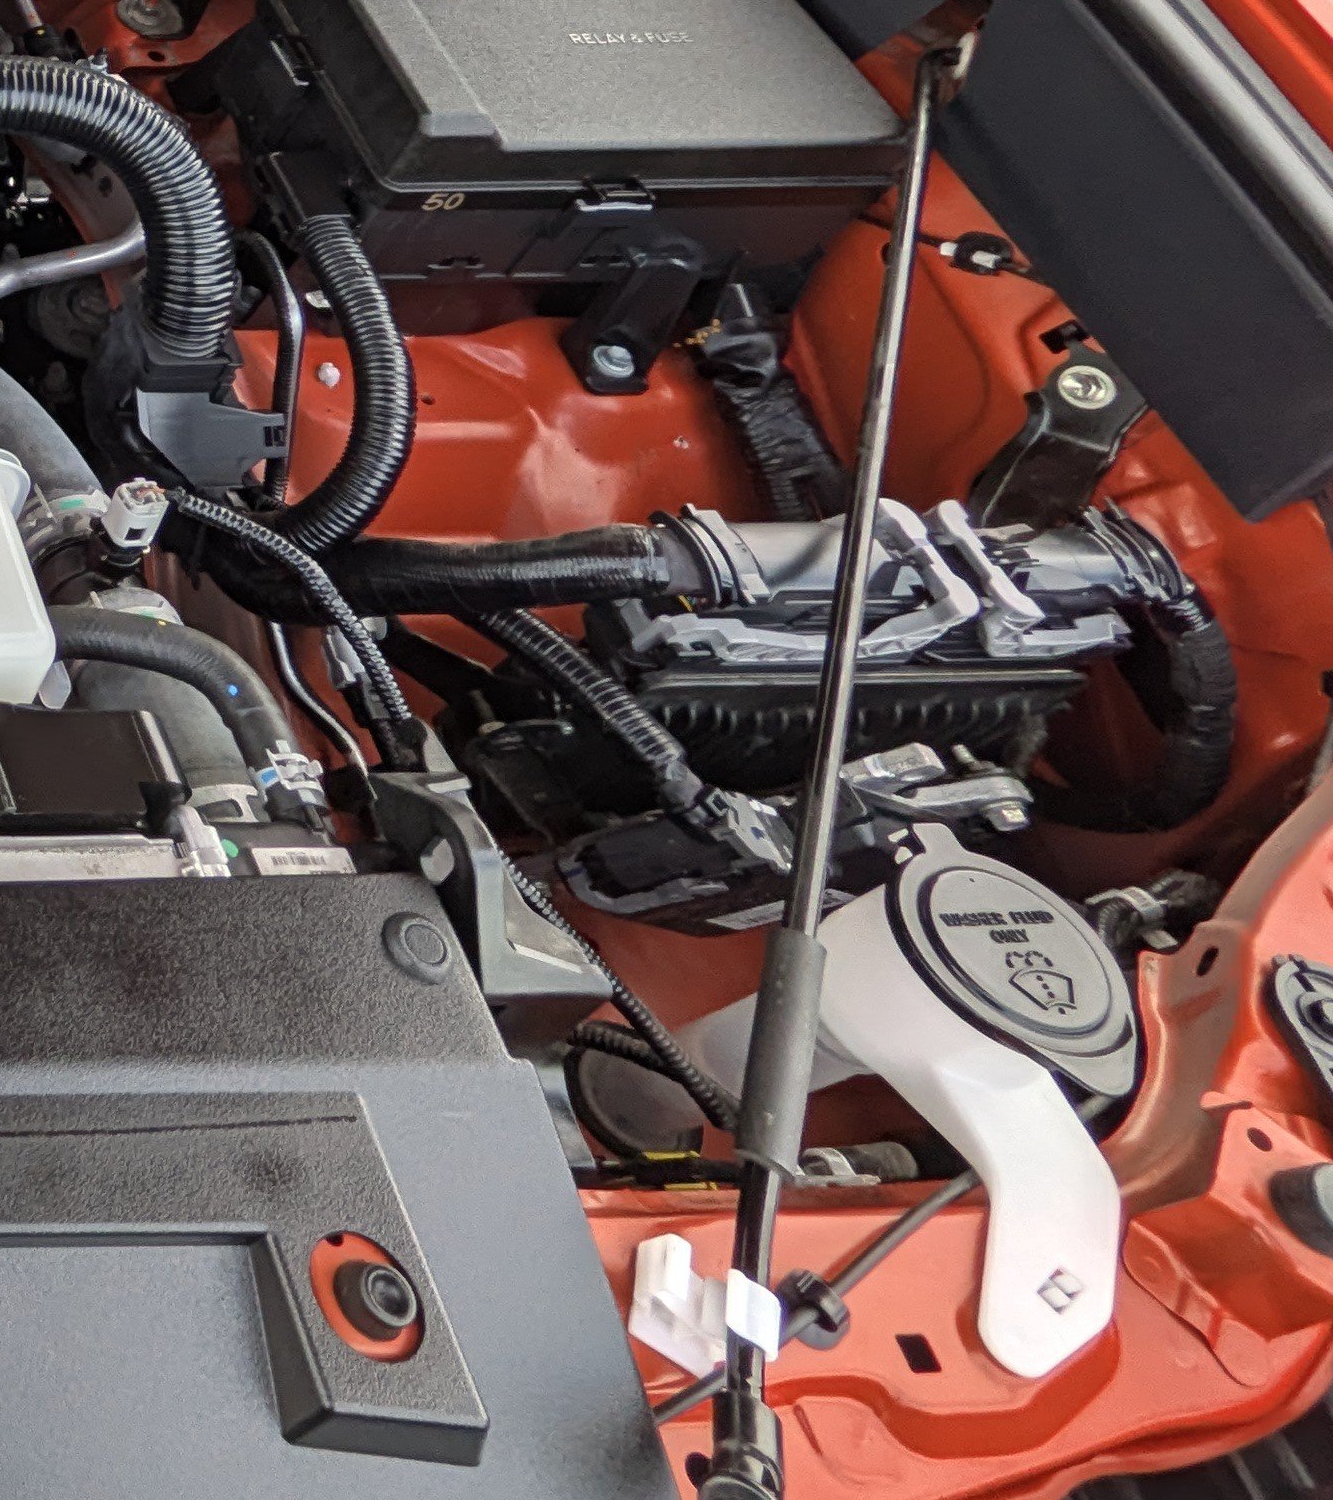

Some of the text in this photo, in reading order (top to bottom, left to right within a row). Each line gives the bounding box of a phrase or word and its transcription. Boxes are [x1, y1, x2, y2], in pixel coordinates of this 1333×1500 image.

[569, 33, 626, 44] RELAY
[644, 32, 694, 43] FUSE
[421, 192, 465, 211] 50
